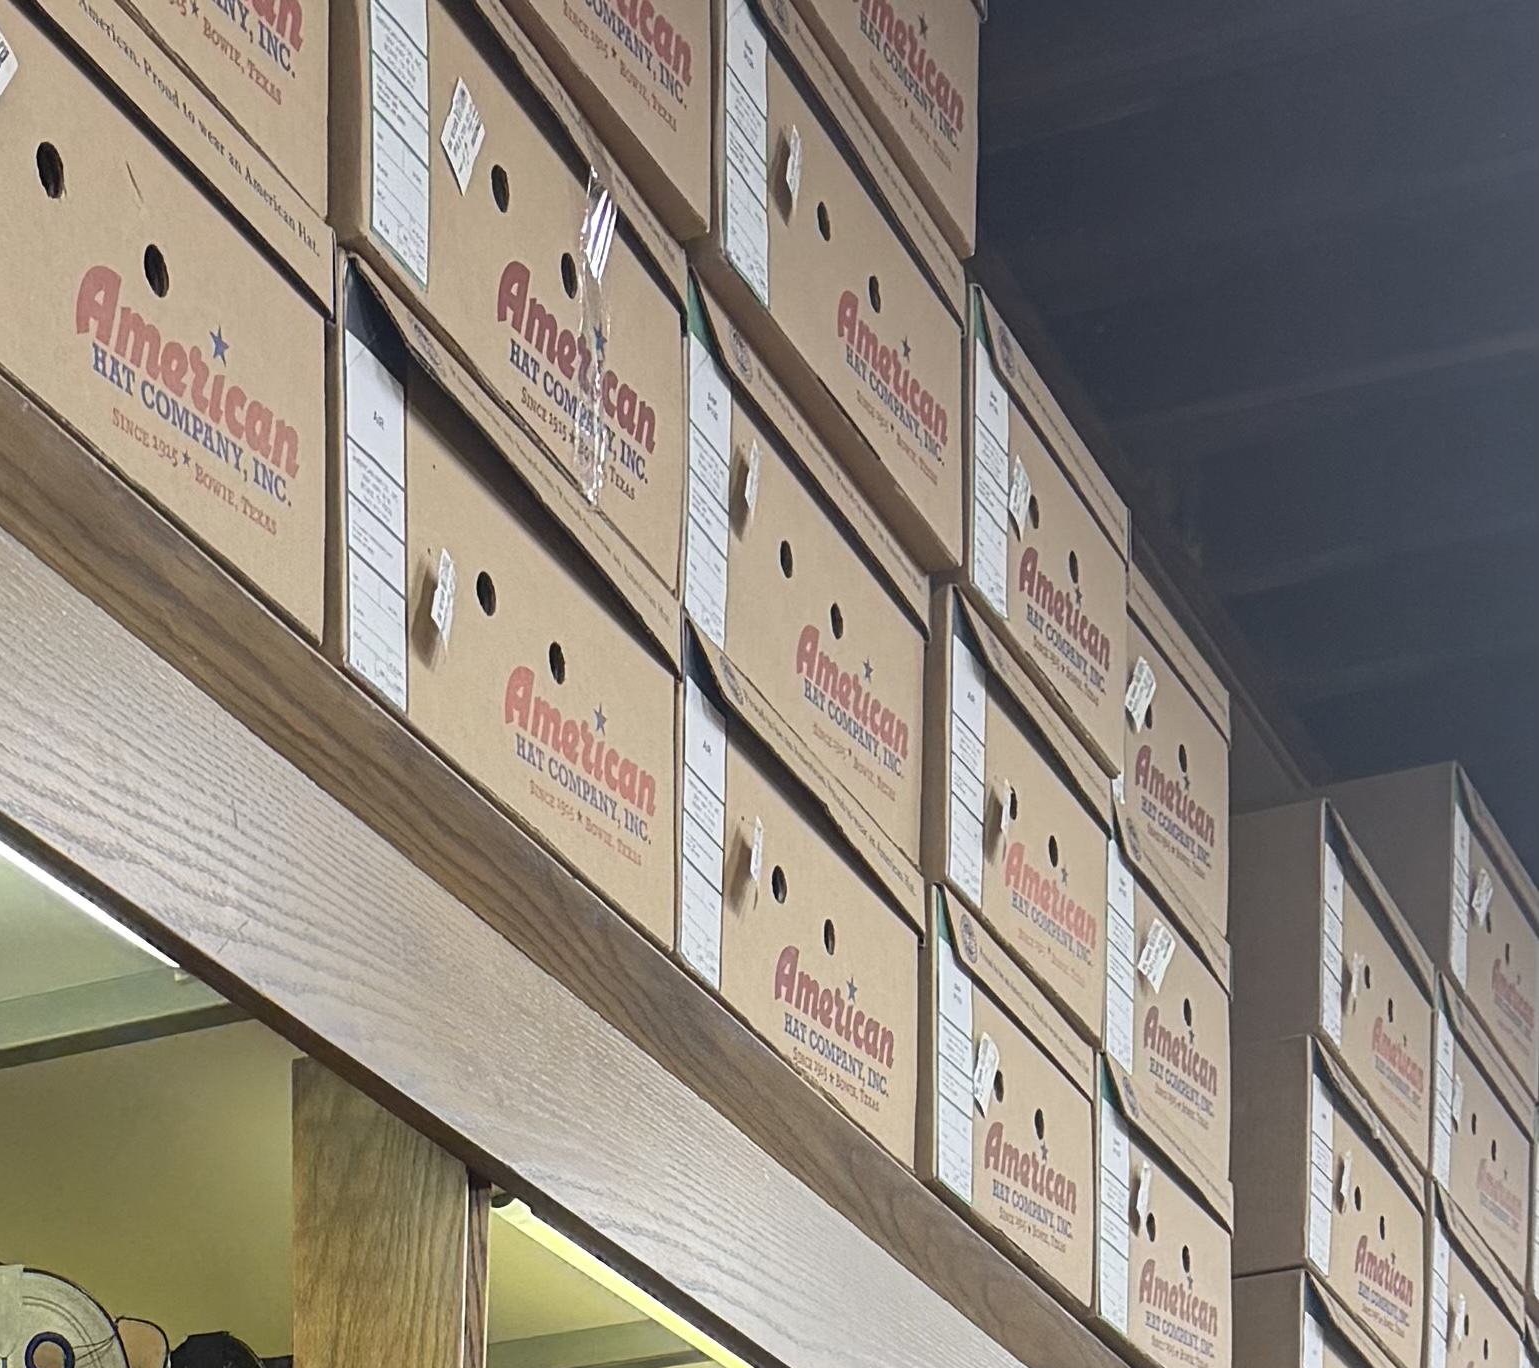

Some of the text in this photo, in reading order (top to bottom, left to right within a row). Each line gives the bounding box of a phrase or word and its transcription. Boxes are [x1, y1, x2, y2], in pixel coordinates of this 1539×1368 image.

[202, 17, 244, 74] BOWIE,
[247, 59, 283, 105] TEXAS
[258, 19, 296, 79] INC.
[584, 0, 653, 82] OMPANY,
[143, 57, 180, 109] Proud
[182, 102, 195, 124] to
[197, 119, 225, 156] wear
[244, 166, 296, 231] American
[75, 264, 300, 479] American
[497, 261, 656, 455] Amercan
[837, 290, 948, 447] American
[845, 342, 867, 384] HAT
[868, 371, 923, 447] COMPANY,
[91, 342, 135, 397] HAT
[140, 380, 249, 482] COMPANY,
[252, 456, 292, 507] INC.
[112, 407, 178, 468] SINCE 1915
[510, 338, 540, 385] HAT
[542, 370, 617, 462] COMPAY,
[620, 438, 649, 485] INC.
[194, 462, 278, 536] BOWIE, TEXAS
[609, 465, 636, 501] TEXAS
[1019, 546, 1110, 673] American
[504, 666, 656, 817] American
[796, 624, 909, 761] American
[804, 677, 825, 712] HAT
[827, 700, 882, 766] COMPANY,
[882, 745, 905, 780] INC.
[515, 732, 652, 845] HAT COMPANY, INC.
[1135, 745, 1215, 849] American
[1005, 841, 1097, 950] American
[774, 945, 895, 1070] American
[783, 1012, 889, 1099] HAT COMPANY, INC.
[1144, 1005, 1218, 1097] American
[984, 1121, 1077, 1217] American
[1139, 1258, 1218, 1338] American
[1355, 1234, 1414, 1308] American
